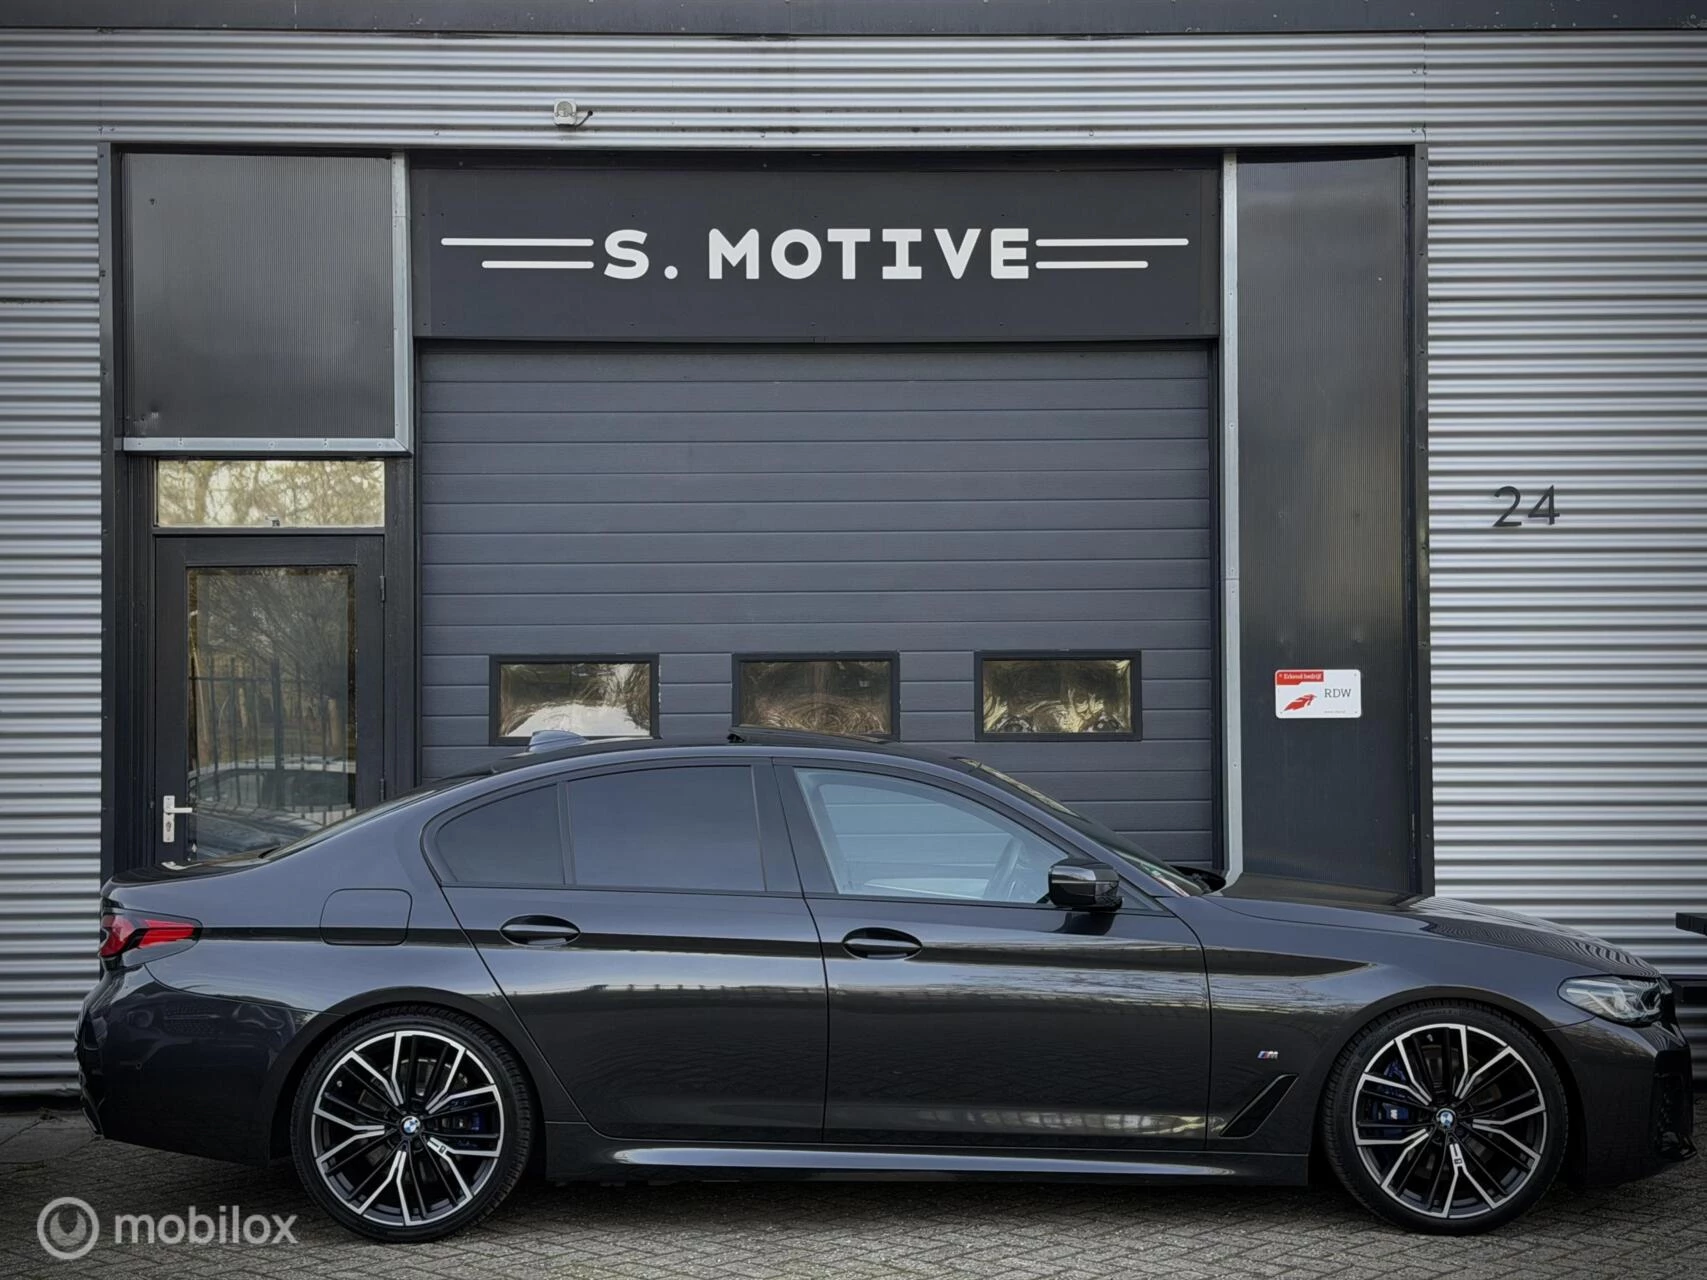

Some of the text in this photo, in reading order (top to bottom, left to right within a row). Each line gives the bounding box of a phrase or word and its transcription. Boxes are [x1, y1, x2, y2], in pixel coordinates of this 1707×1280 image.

[603, 228, 1030, 280] S. MOTIVE
[1492, 484, 1561, 528] 24
[1324, 688, 1352, 698] RDW
